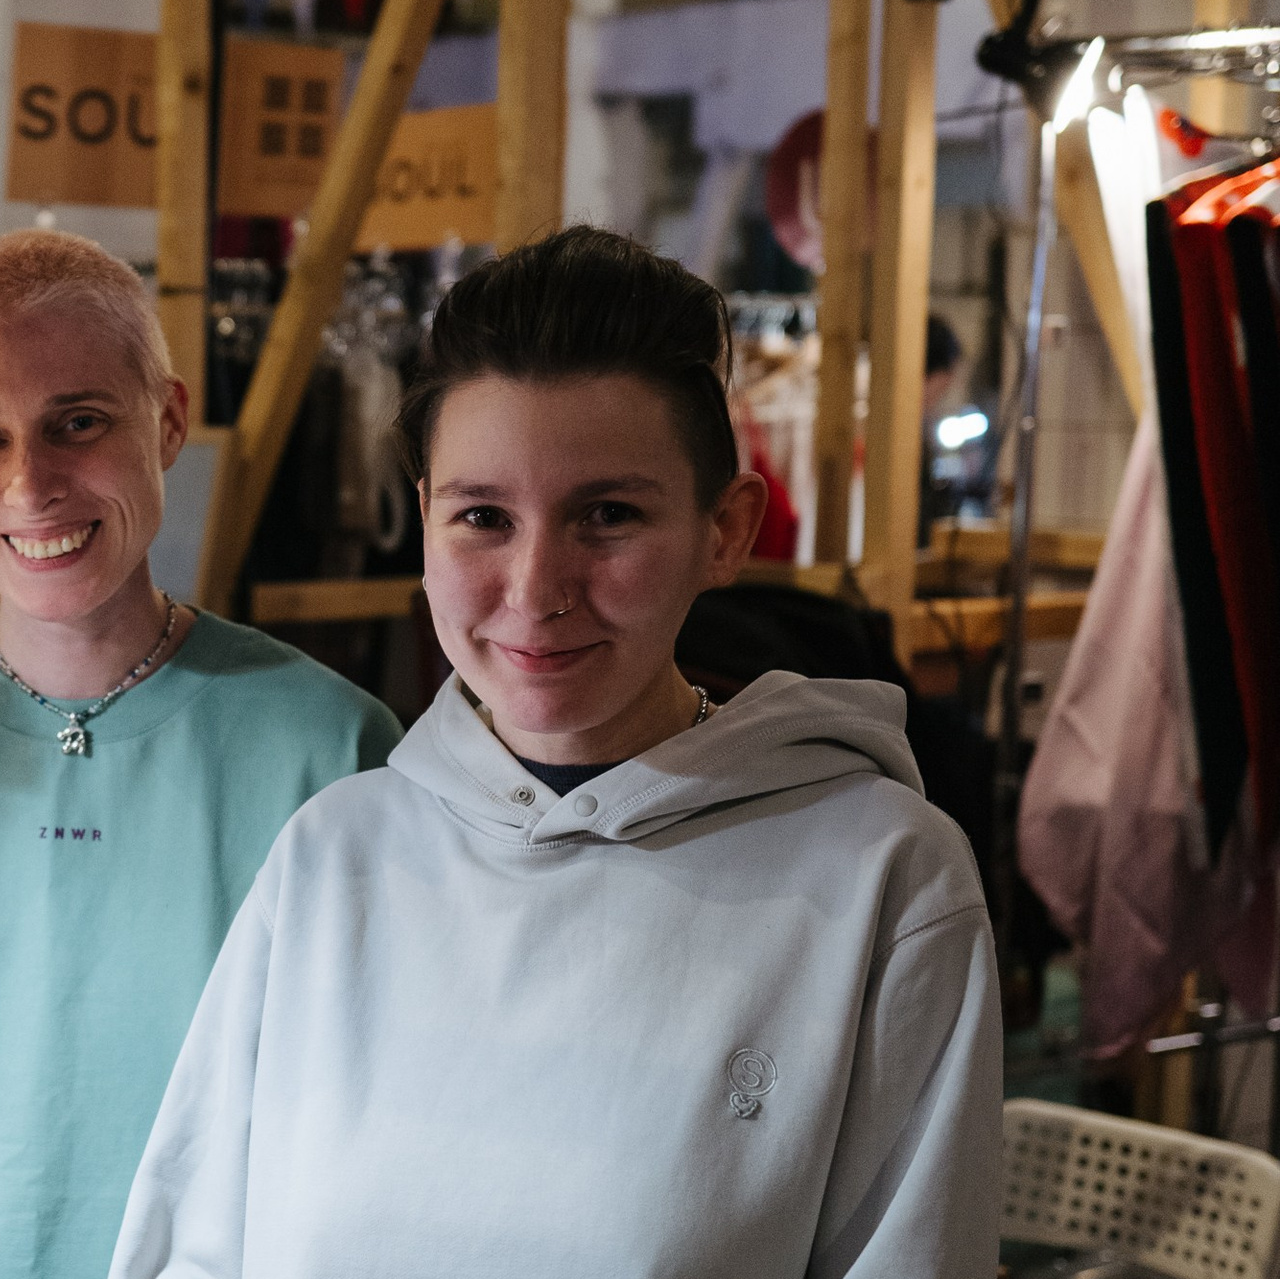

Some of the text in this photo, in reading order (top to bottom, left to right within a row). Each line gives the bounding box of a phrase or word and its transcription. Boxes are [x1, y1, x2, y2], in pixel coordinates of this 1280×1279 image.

[18, 83, 158, 149] SOU
[377, 153, 476, 203] OUL
[39, 827, 102, 841] ZNWR
